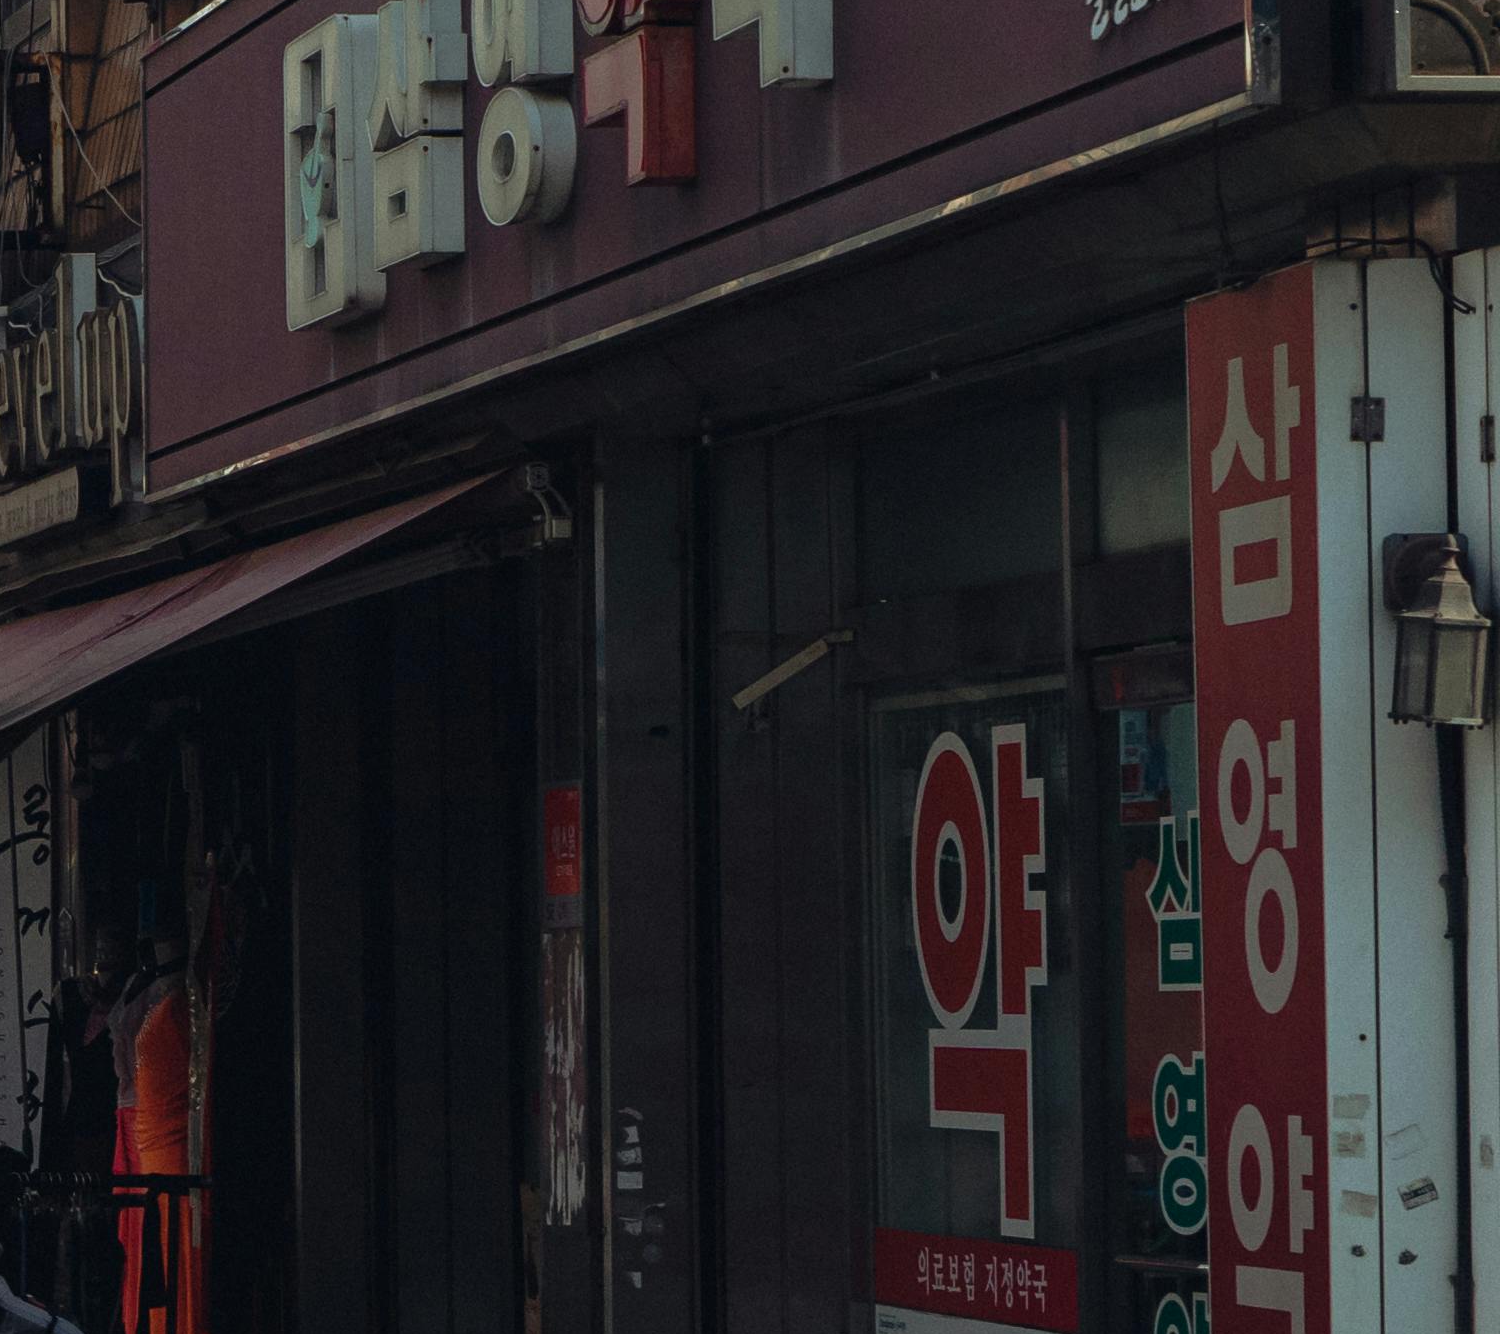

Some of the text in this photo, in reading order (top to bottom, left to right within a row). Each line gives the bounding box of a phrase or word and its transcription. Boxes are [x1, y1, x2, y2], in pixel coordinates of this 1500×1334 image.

[910, 722, 1048, 1239] 약
[917, 1246, 1050, 1315] 의료보험 지정약국
